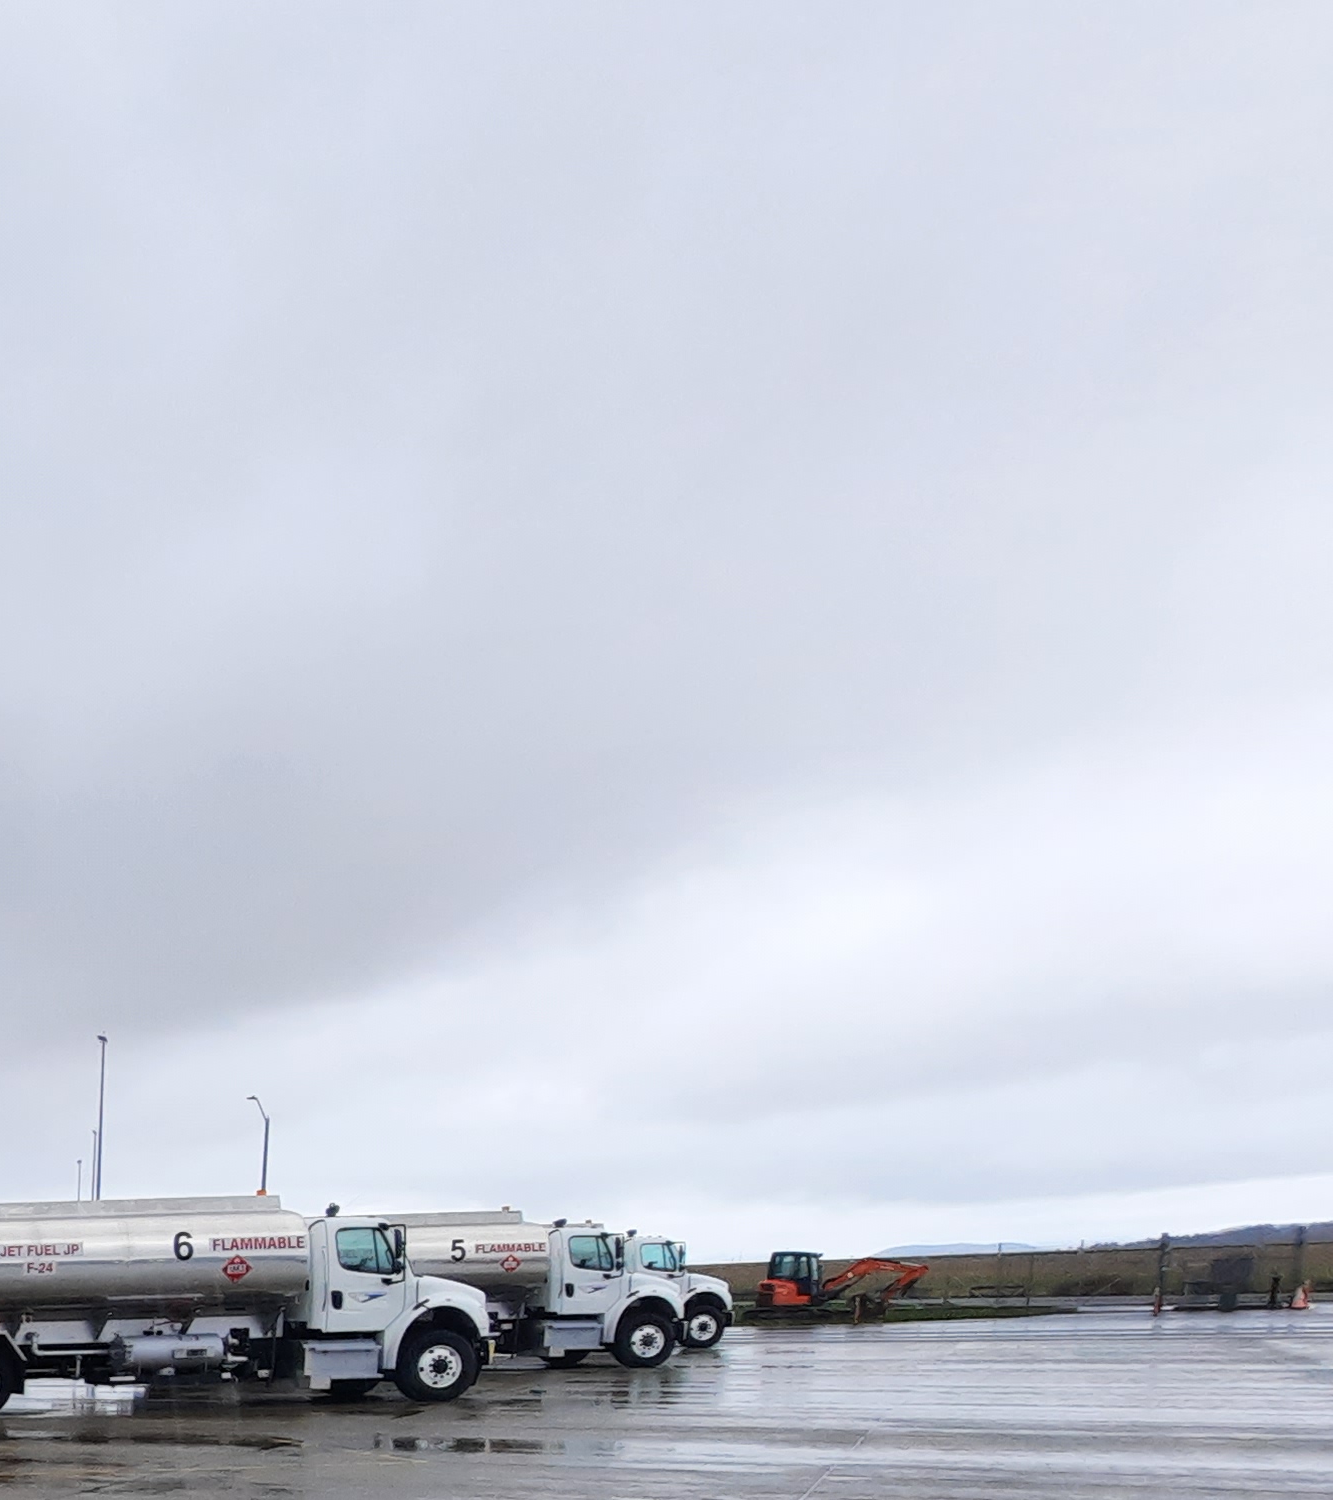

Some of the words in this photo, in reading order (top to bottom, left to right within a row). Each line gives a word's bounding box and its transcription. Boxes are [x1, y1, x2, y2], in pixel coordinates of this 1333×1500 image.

[0, 1246, 23, 1257] JET
[27, 1245, 60, 1256] FUEL
[63, 1244, 80, 1256] JP
[174, 1231, 193, 1260] 6
[213, 1236, 305, 1251] FLAMMABLE
[451, 1239, 466, 1261] 5
[475, 1242, 546, 1254] FLAMMABLE
[27, 1262, 54, 1274] F-24
